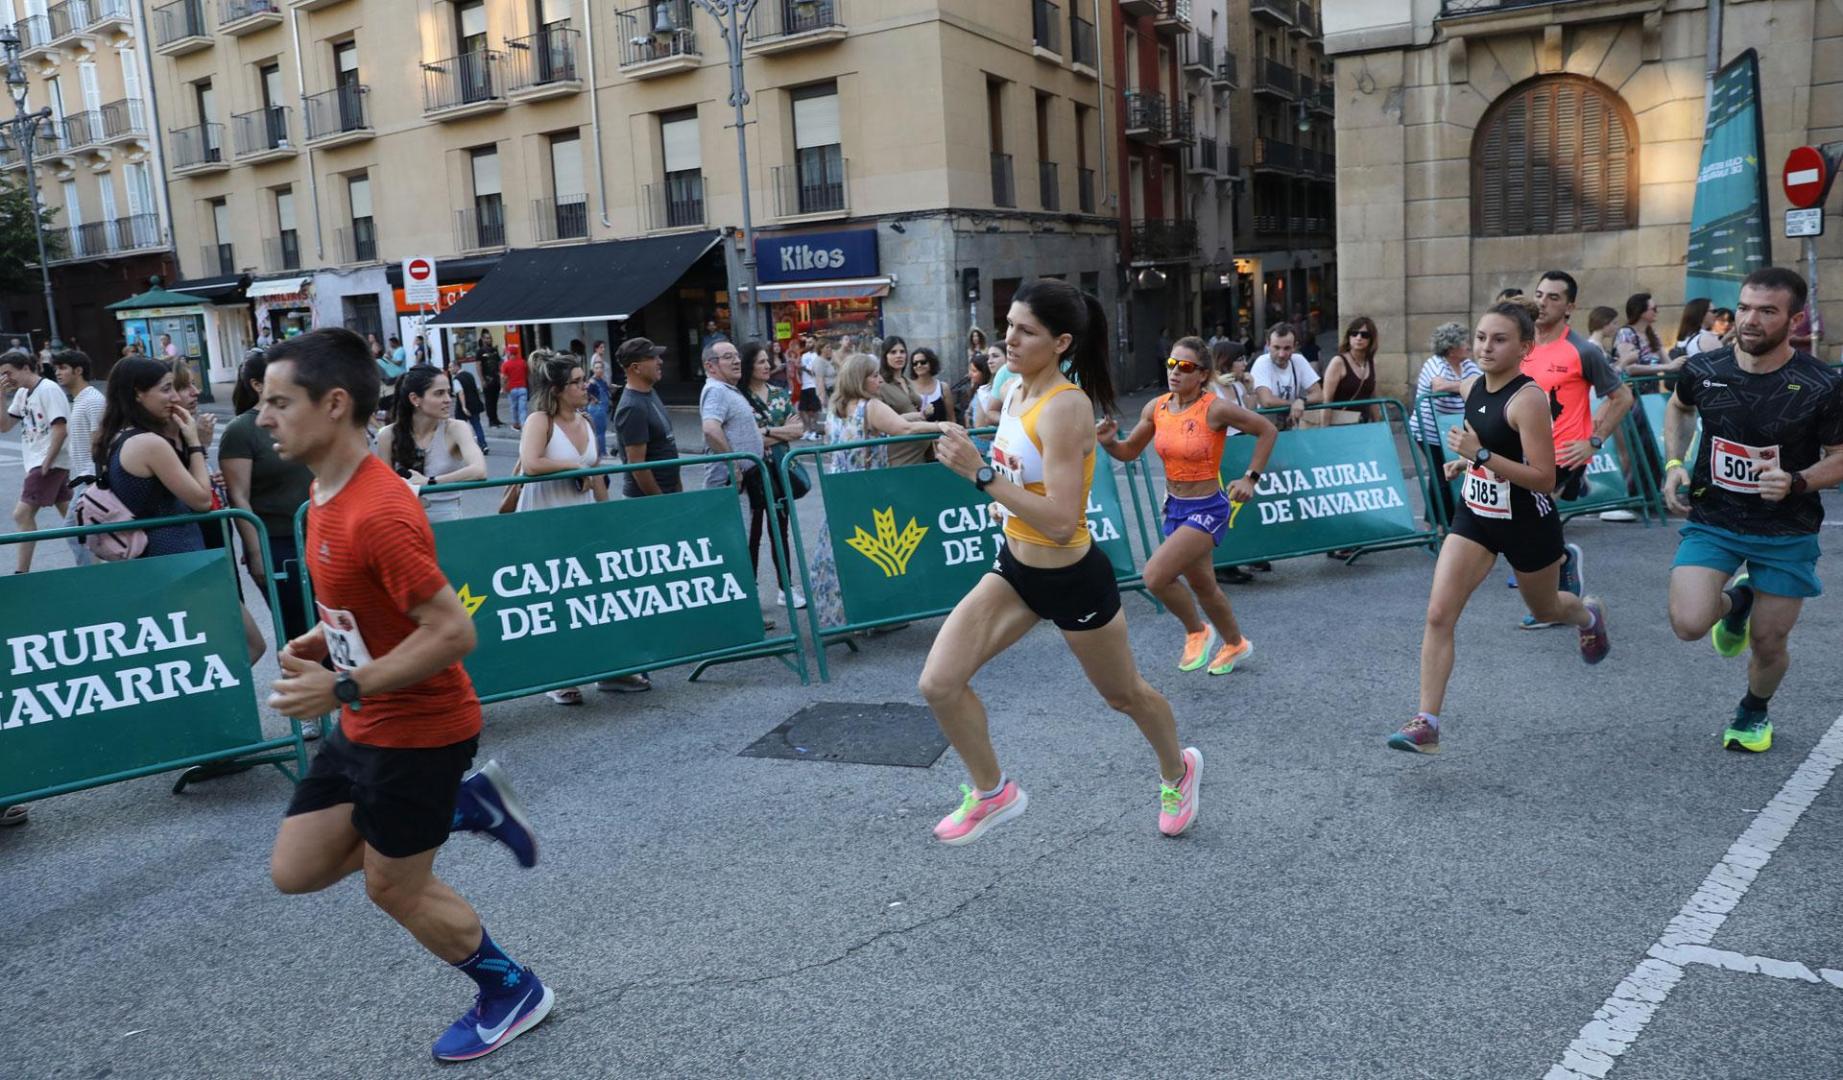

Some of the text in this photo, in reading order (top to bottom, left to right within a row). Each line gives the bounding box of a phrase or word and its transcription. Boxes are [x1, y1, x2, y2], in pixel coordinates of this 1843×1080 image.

[780, 244, 845, 271] Kikos
[1254, 460, 1388, 496] CAJA RURAL
[1469, 478, 1498, 506] 5185
[1257, 486, 1405, 525] DE NAVARRA
[492, 537, 724, 598] CAJA RURAL
[942, 536, 985, 566] DE
[497, 572, 747, 641] DE NAVARRA
[7, 611, 206, 676] RURAL
[0, 653, 240, 730] AVARRA
